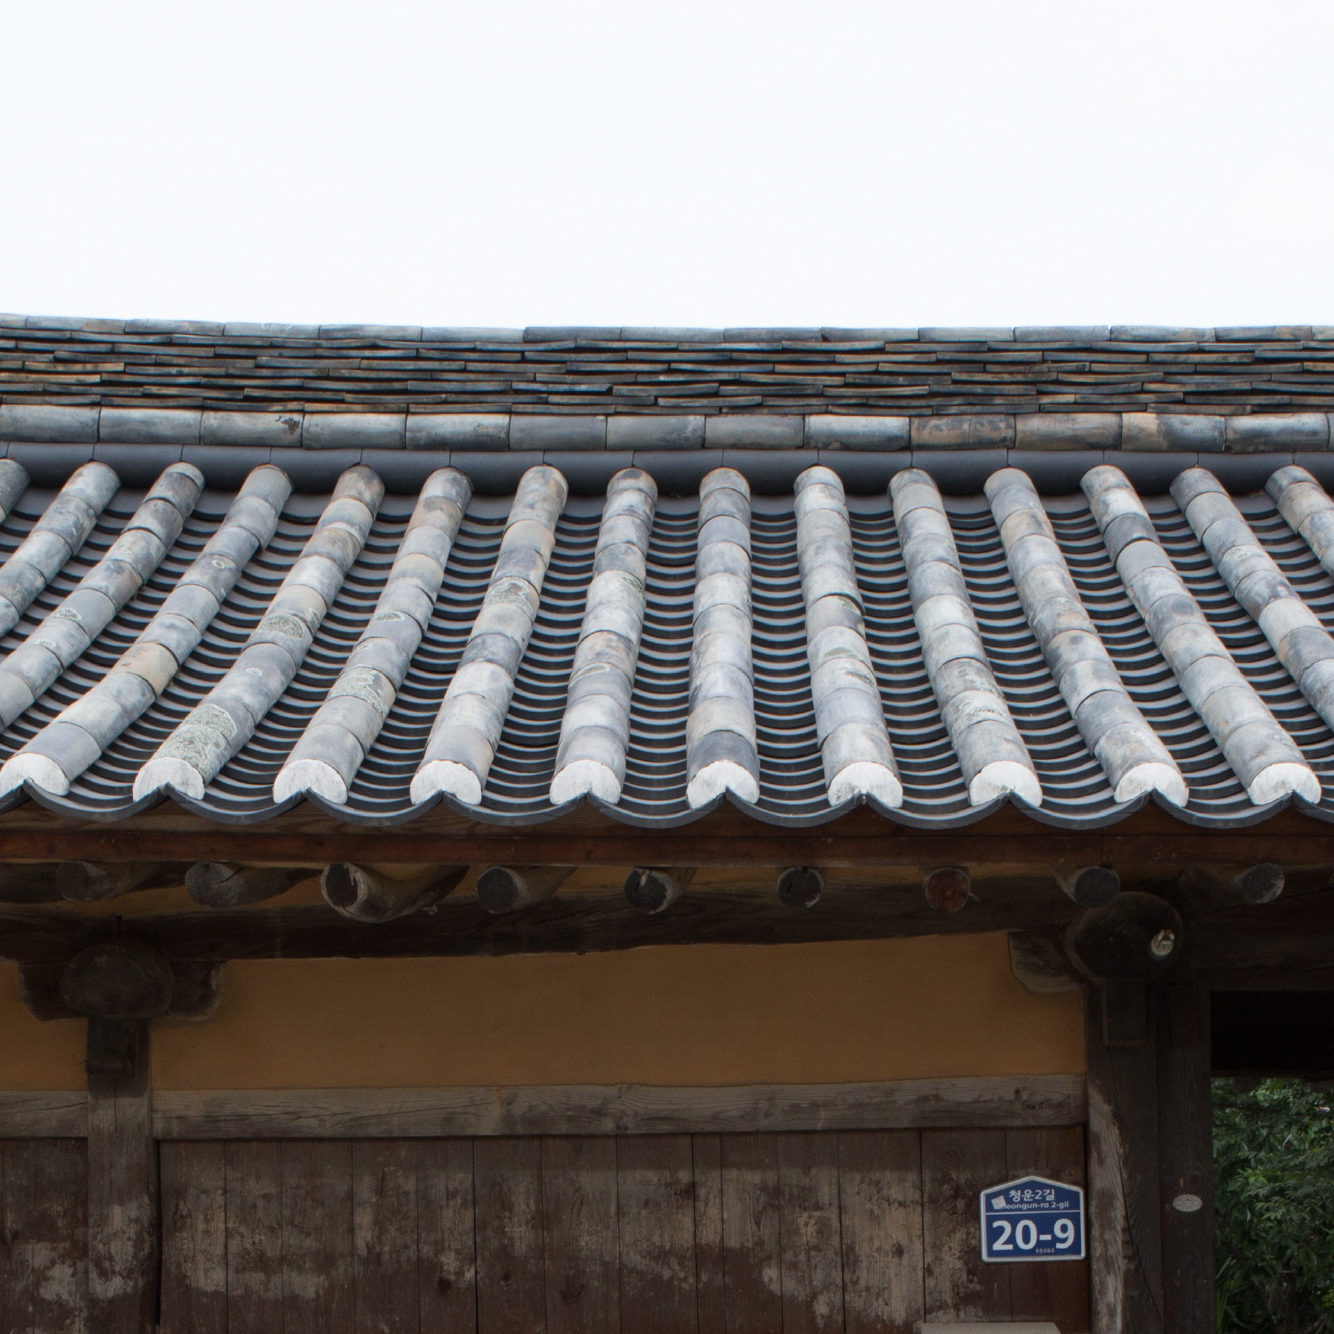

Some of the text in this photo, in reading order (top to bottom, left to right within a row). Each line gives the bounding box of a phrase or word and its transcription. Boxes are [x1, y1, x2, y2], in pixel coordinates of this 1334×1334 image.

[1009, 1189, 1055, 1202] 청운2길
[996, 1201, 1069, 1211] heongun-ro 2-gil
[992, 1218, 1075, 1251] 20-9
